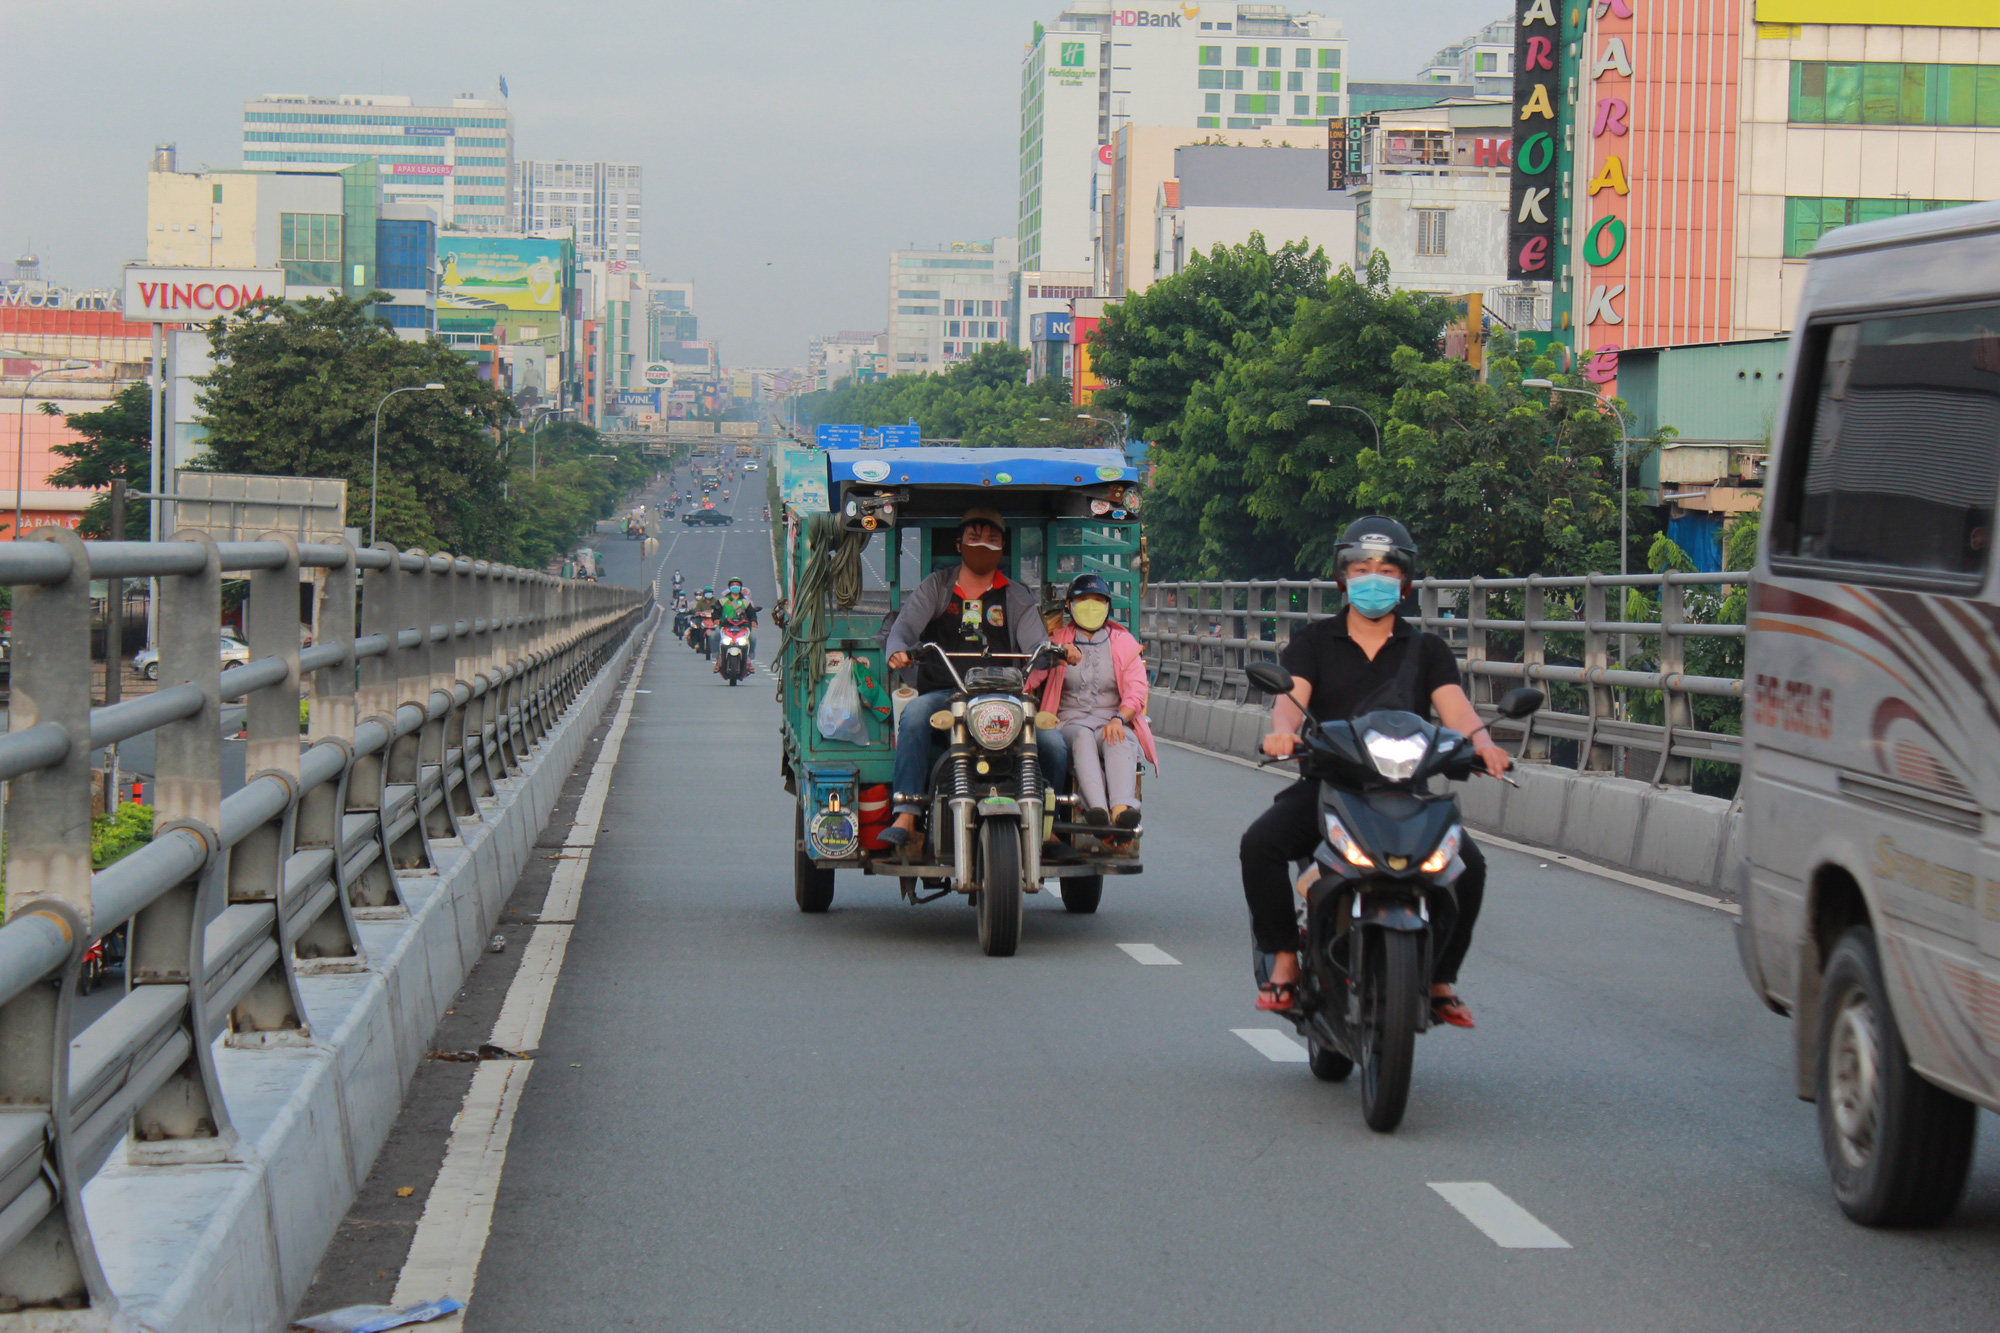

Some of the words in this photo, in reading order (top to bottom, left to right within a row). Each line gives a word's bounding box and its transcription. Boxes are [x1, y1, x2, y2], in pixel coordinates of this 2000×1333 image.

[1112, 10, 1182, 28] HDBank
[1048, 68, 1080, 79] Holiday
[1082, 69, 1096, 78] Inn
[1330, 131, 1345, 139] LONG
[1349, 118, 1361, 173] HOTEL
[418, 166, 449, 174] LEADERS
[1332, 141, 1343, 189] HOTEL
[138, 282, 265, 310] VINCOM
[35, 516, 60, 527] RÁN
